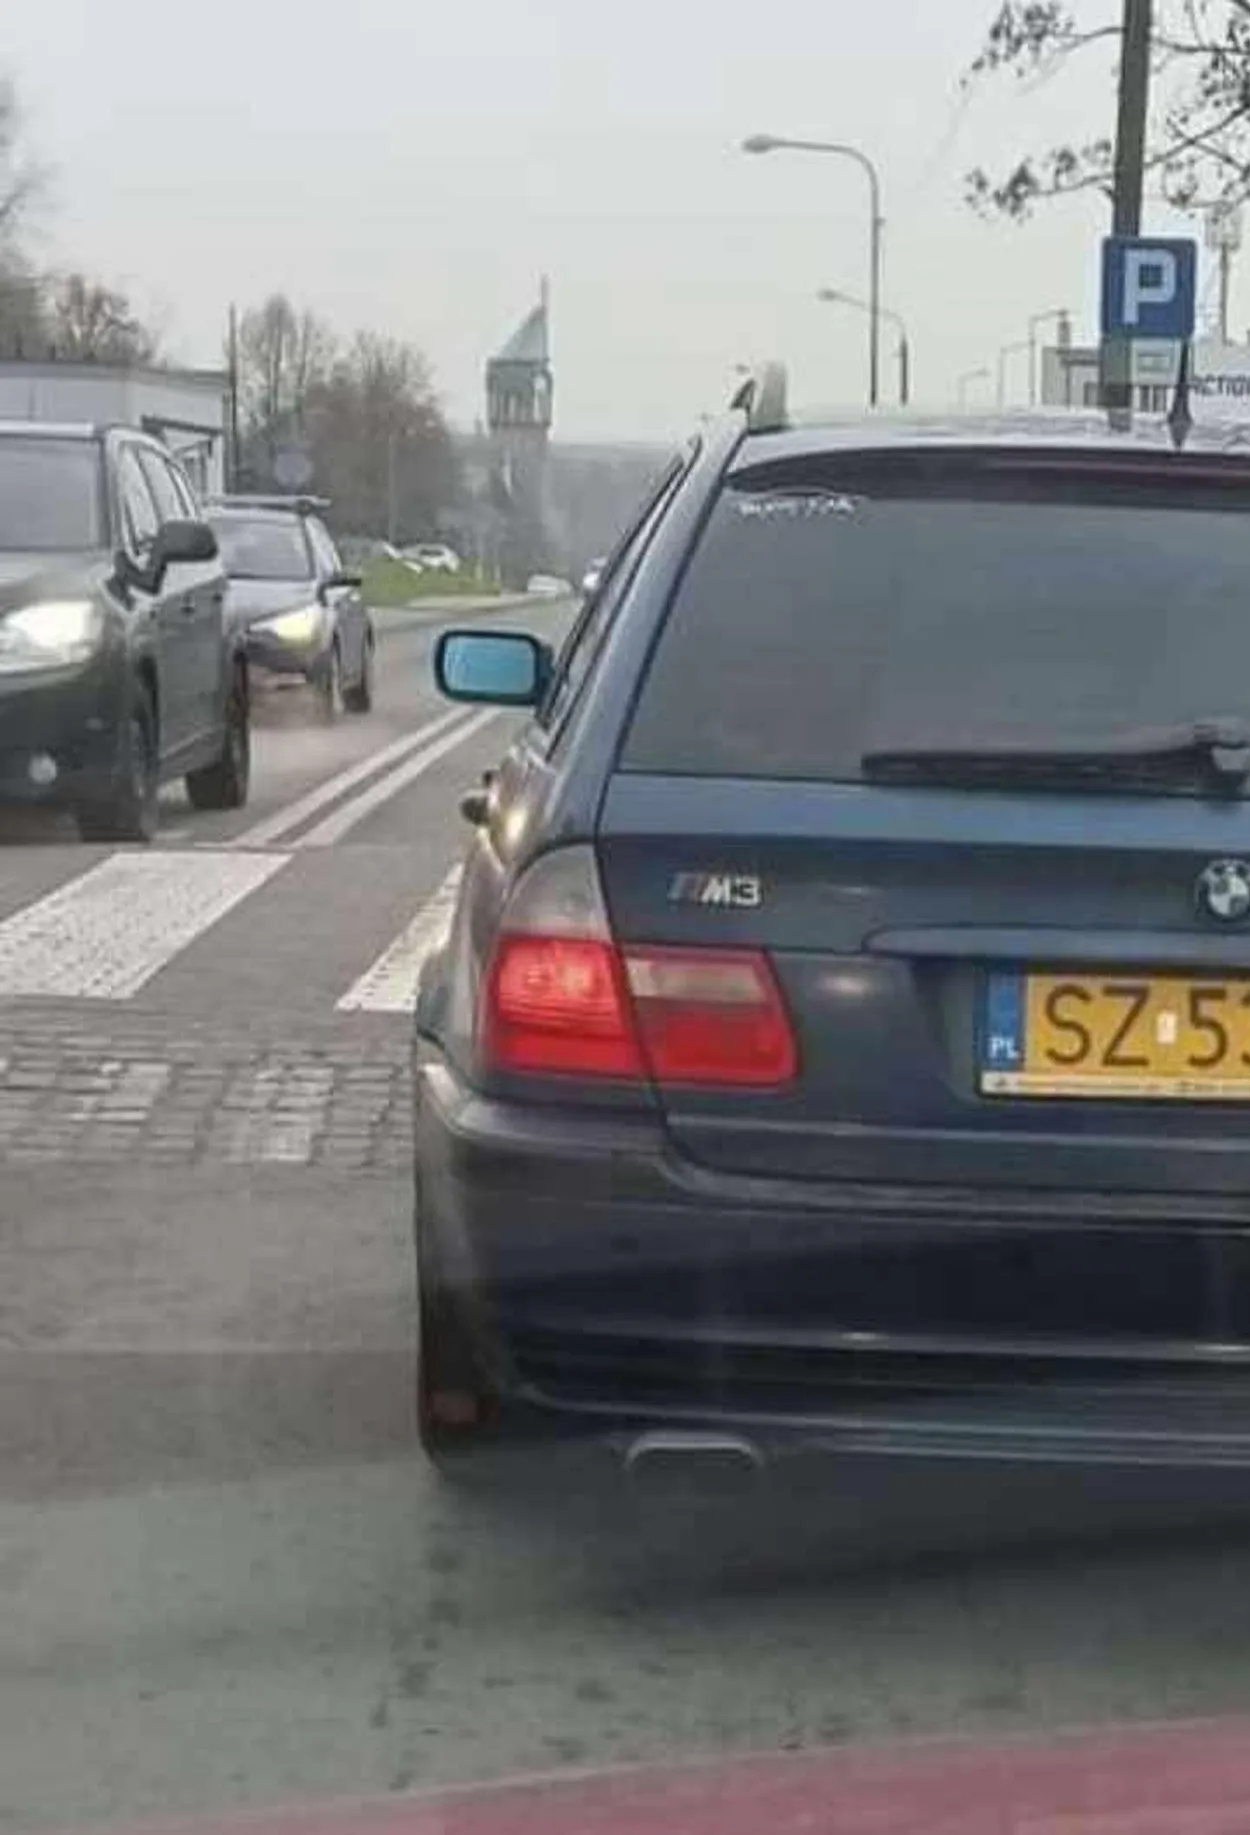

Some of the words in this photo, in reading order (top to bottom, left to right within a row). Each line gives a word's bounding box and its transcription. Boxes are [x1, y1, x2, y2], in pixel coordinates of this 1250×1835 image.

[1123, 249, 1176, 325] P
[990, 1036, 1019, 1059] PL
[1044, 984, 1150, 1068] SZ
